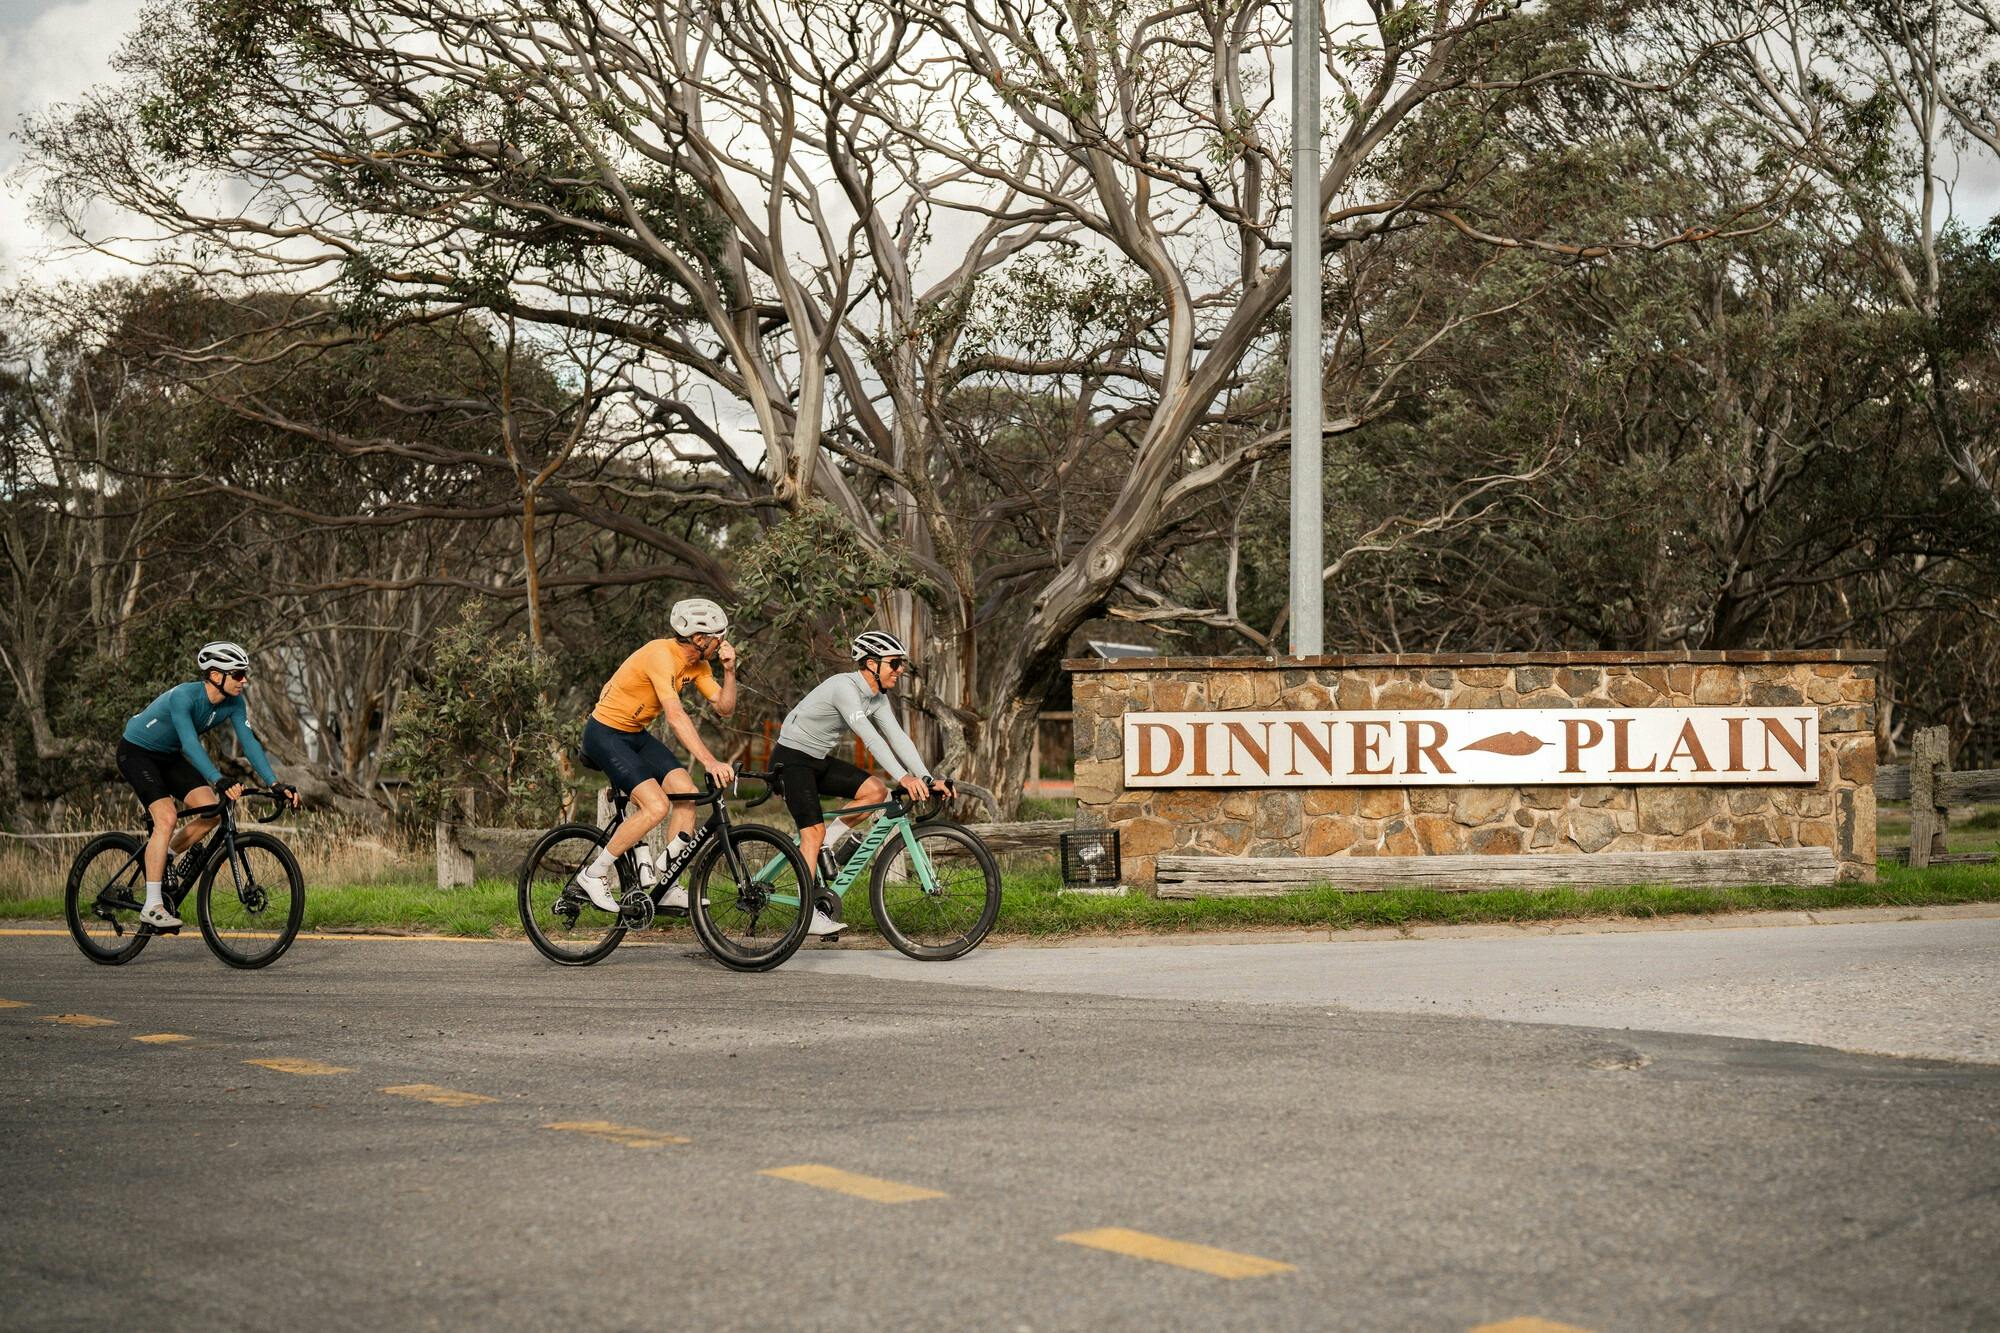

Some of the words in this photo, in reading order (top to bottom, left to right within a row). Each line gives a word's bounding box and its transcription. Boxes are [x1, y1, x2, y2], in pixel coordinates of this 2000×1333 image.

[1131, 719, 1457, 778] DINNER
[1558, 716, 1813, 774] PLAIN
[836, 825, 891, 886] CANYON
